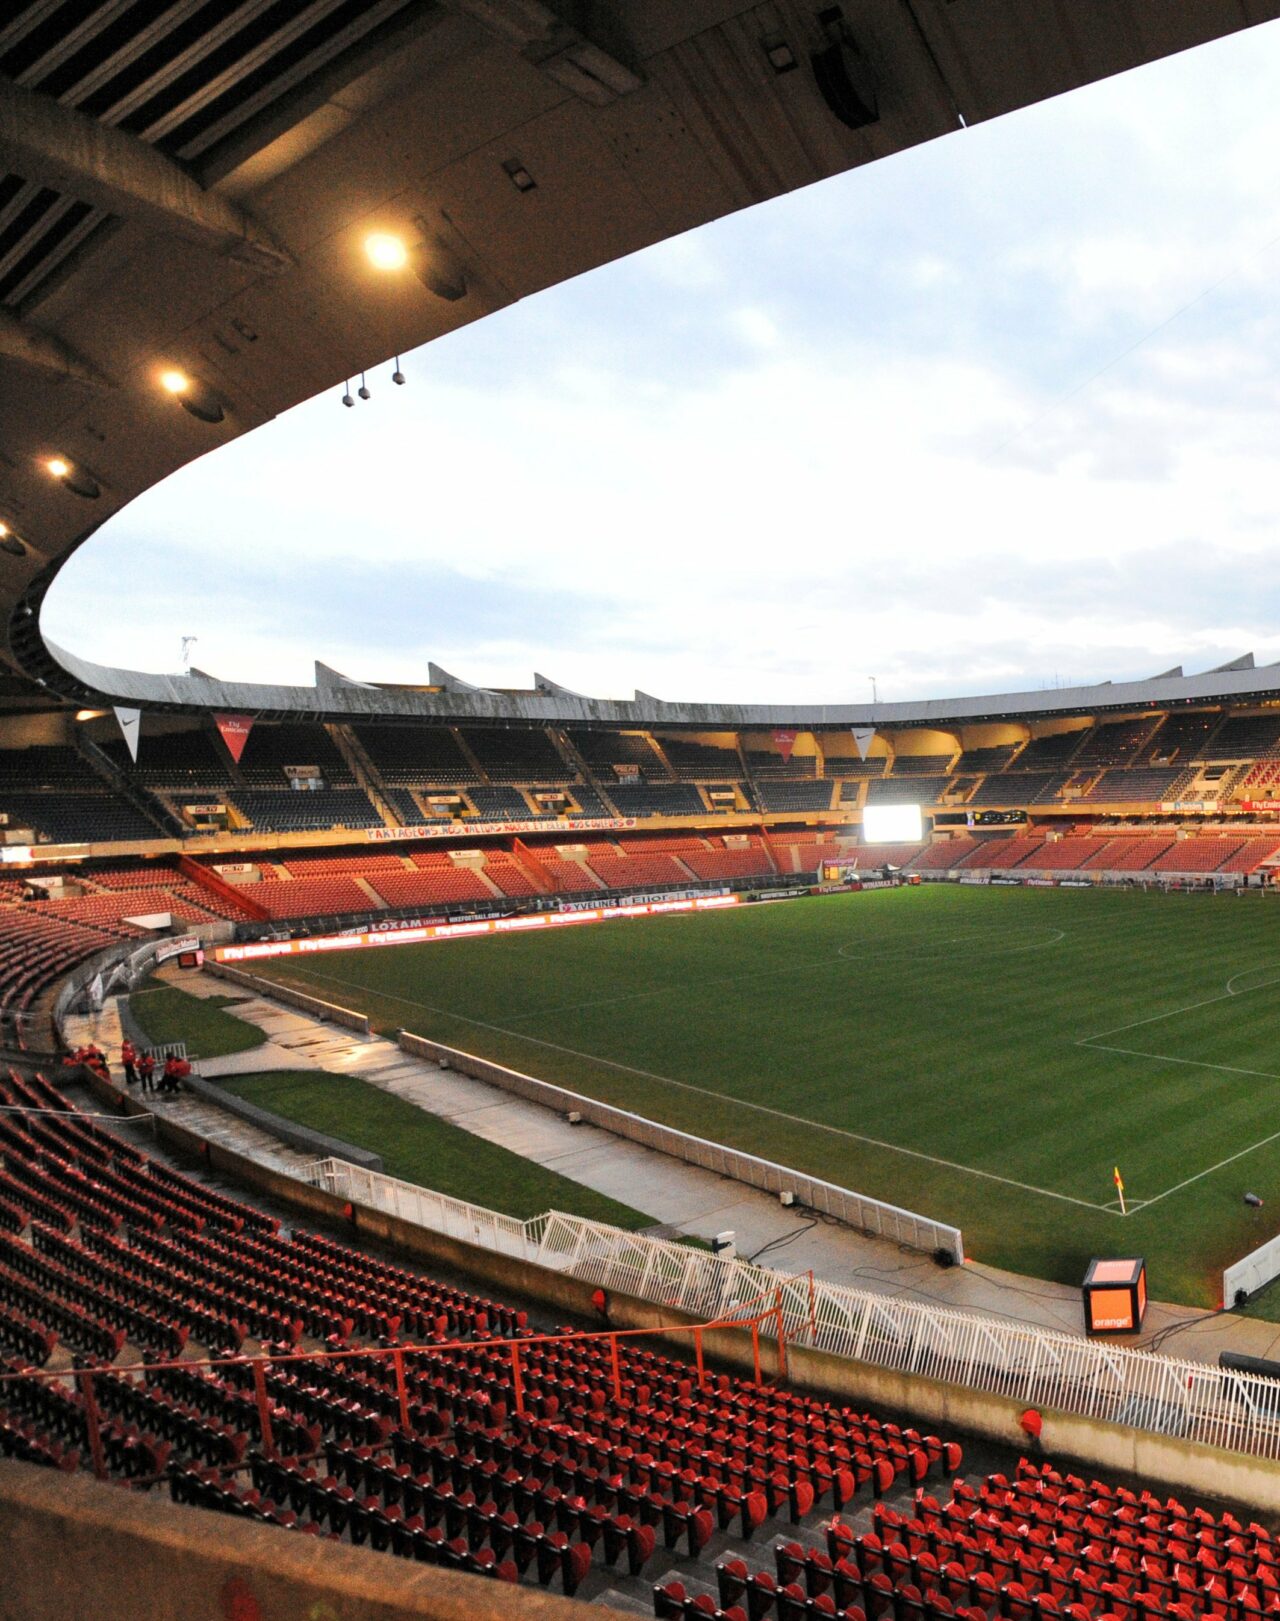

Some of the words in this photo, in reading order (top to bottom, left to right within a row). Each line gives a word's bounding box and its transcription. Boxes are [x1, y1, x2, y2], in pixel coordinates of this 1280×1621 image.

[1252, 801, 1263, 810] Fly
[367, 827, 438, 839] PARTAGEONS
[371, 919, 422, 932] LOXAM
[224, 948, 244, 960] Fly
[244, 943, 292, 957] Emirates
[300, 941, 318, 951] Fly
[1094, 1318, 1128, 1328] orange
